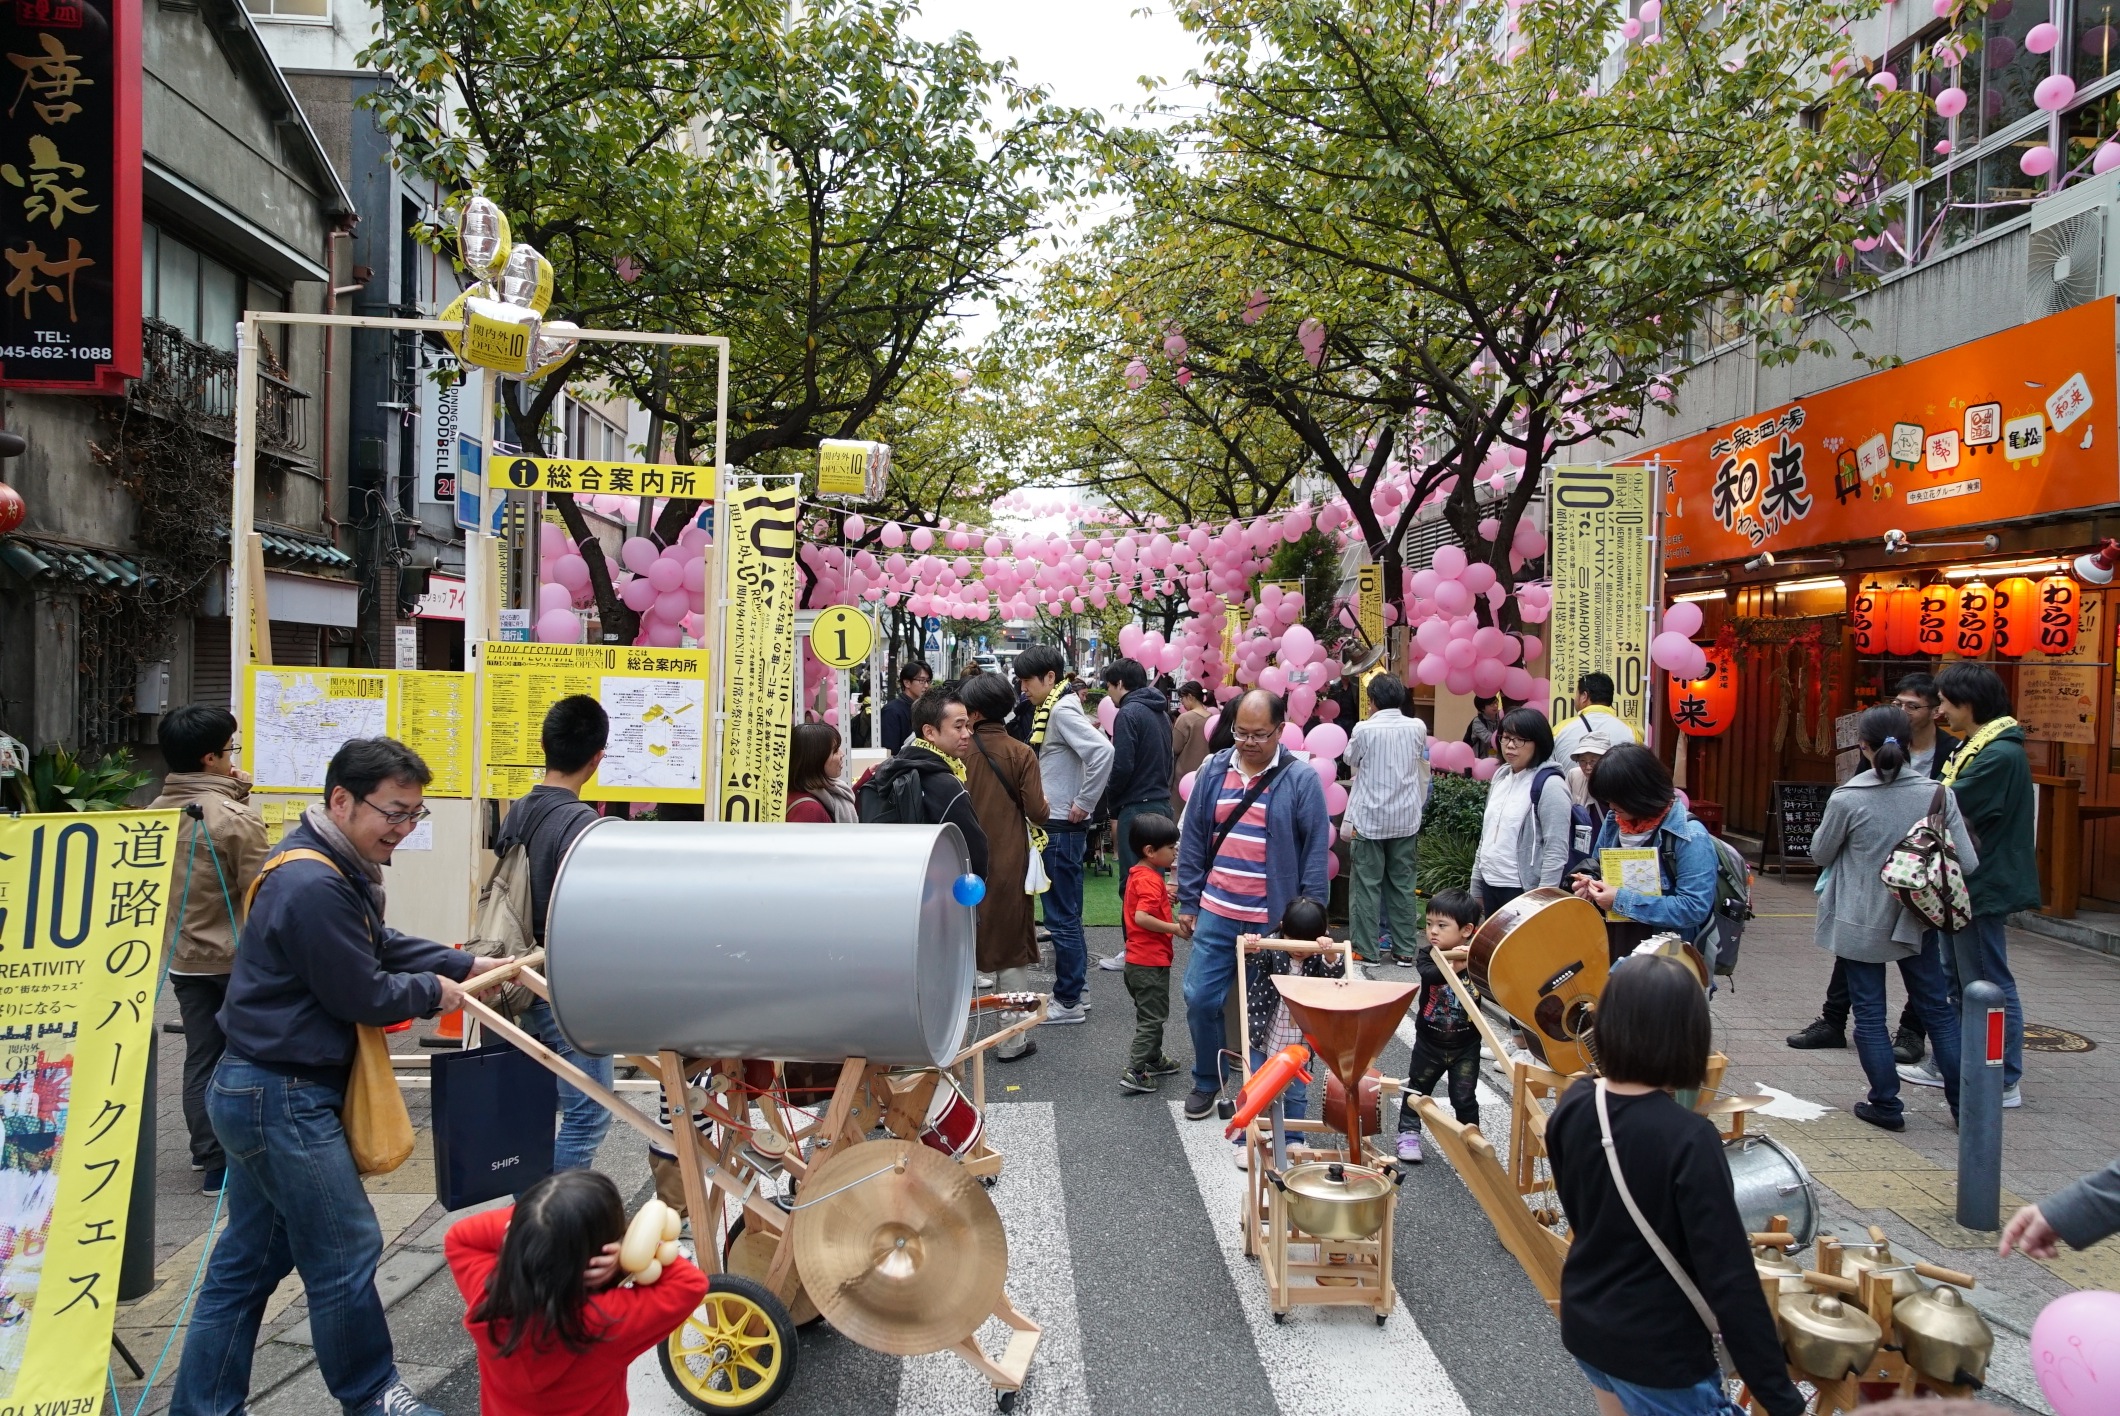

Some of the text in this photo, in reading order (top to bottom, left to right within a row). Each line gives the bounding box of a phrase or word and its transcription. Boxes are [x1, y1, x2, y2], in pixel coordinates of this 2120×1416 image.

[1, 32, 100, 323] 唐家村
[34, 331, 70, 343] TEL:
[450, 388, 458, 421] DINING
[1711, 408, 1805, 458] 大衆酒場
[547, 464, 696, 495] 総合案内所
[1713, 436, 1811, 528] 和来
[1738, 514, 1779, 546] わらい
[1920, 596, 1947, 643] わらい
[1958, 592, 1987, 650] わらい
[2041, 583, 2073, 647] わらい
[605, 649, 616, 669] 10
[627, 657, 697, 672] 総合案内所
[23, 822, 99, 949] 10
[0, 1001, 77, 1018] りになる〜
[54, 820, 170, 1316] 道路のパークフェス
[491, 1155, 520, 1171] SHIPS
